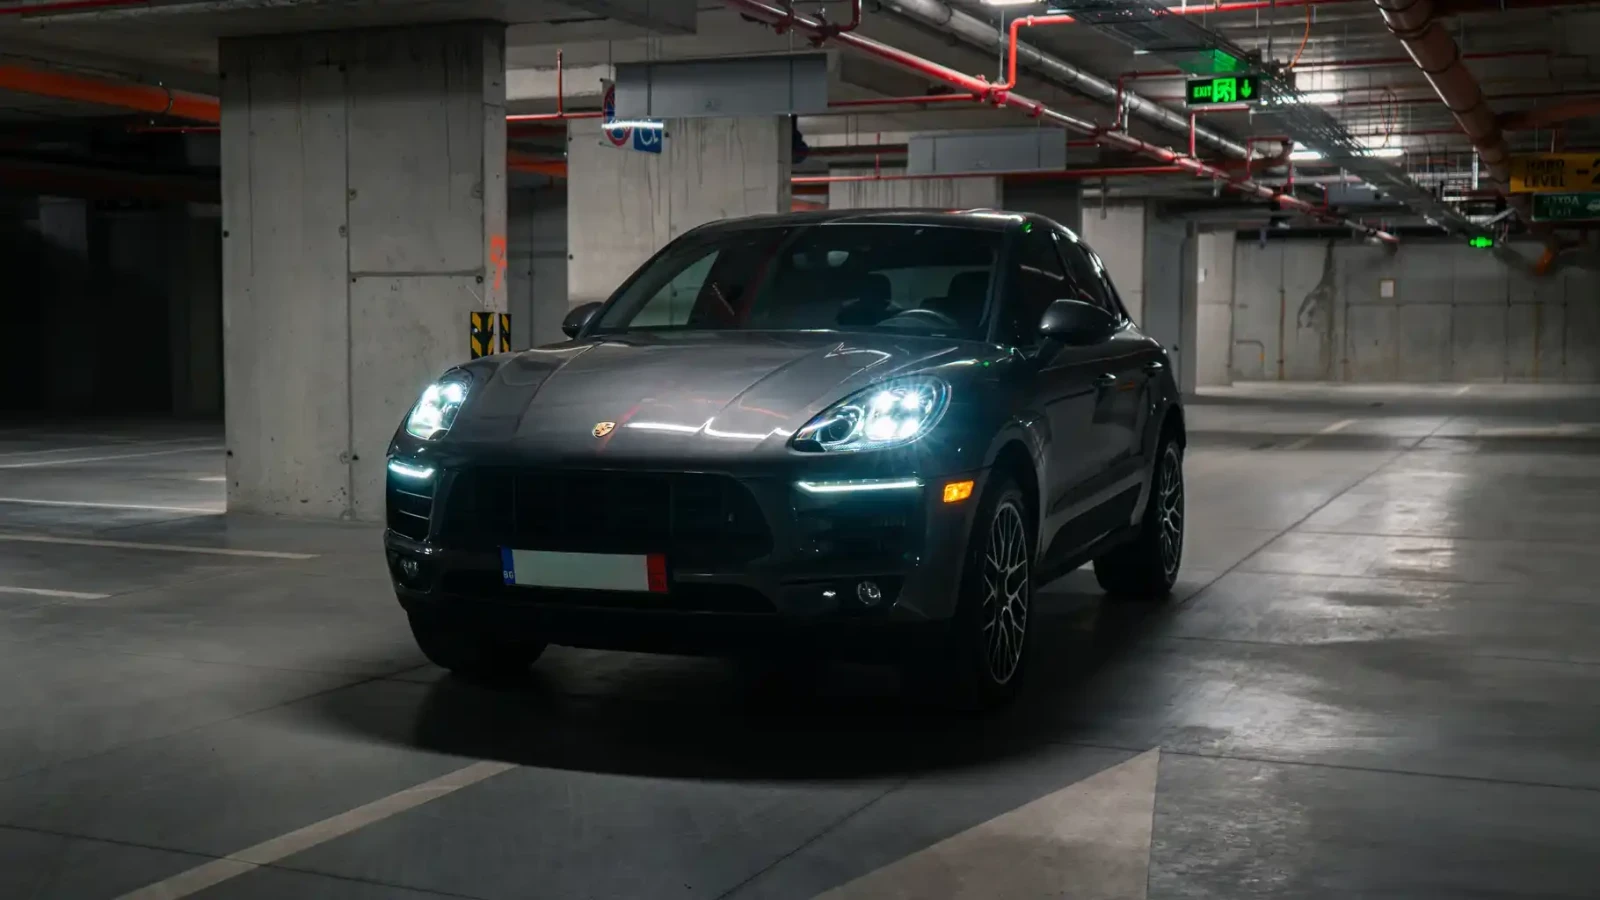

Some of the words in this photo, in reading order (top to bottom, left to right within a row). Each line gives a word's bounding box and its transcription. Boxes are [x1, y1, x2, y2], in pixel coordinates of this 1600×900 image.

[1193, 85, 1212, 98] EXIT
[1524, 175, 1565, 188] LEVEL
[503, 570, 514, 579] BG
